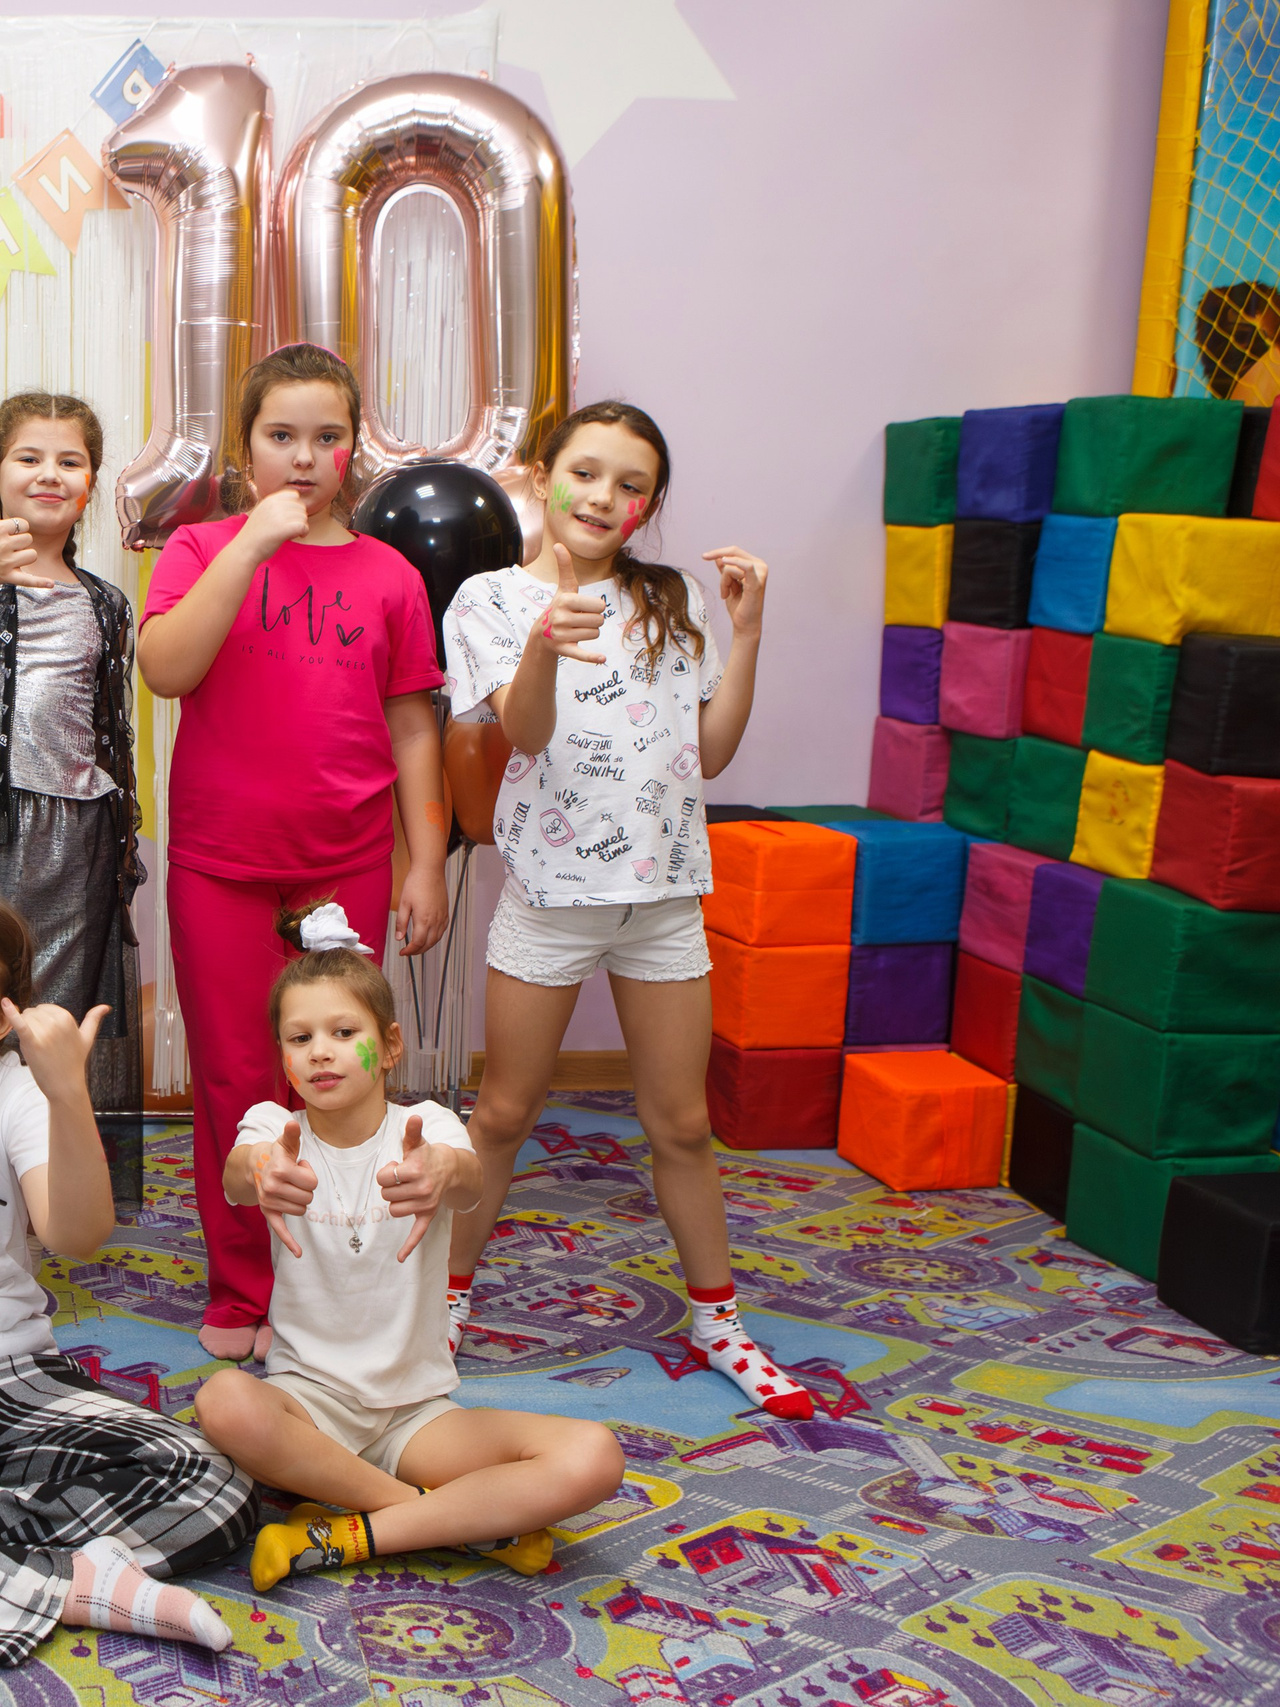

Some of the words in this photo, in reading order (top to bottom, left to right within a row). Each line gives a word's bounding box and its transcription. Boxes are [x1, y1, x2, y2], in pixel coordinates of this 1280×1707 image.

[102, 62, 580, 552] 10
[261, 566, 352, 646] love
[241, 644, 255, 655] IS
[266, 648, 286, 661] ALL
[299, 654, 325, 665] YOU
[334, 657, 367, 671] NEED
[573, 670, 624, 703] travel
[595, 686, 628, 706] time
[565, 733, 613, 752] DREAMS
[588, 752, 613, 764] YOUR
[572, 761, 627, 782] THINGS
[677, 817, 690, 840] STAY
[575, 826, 629, 860] travel
[598, 843, 633, 863] time
[667, 840, 690, 874] HAPPY
[307, 1207, 367, 1229] ashion
